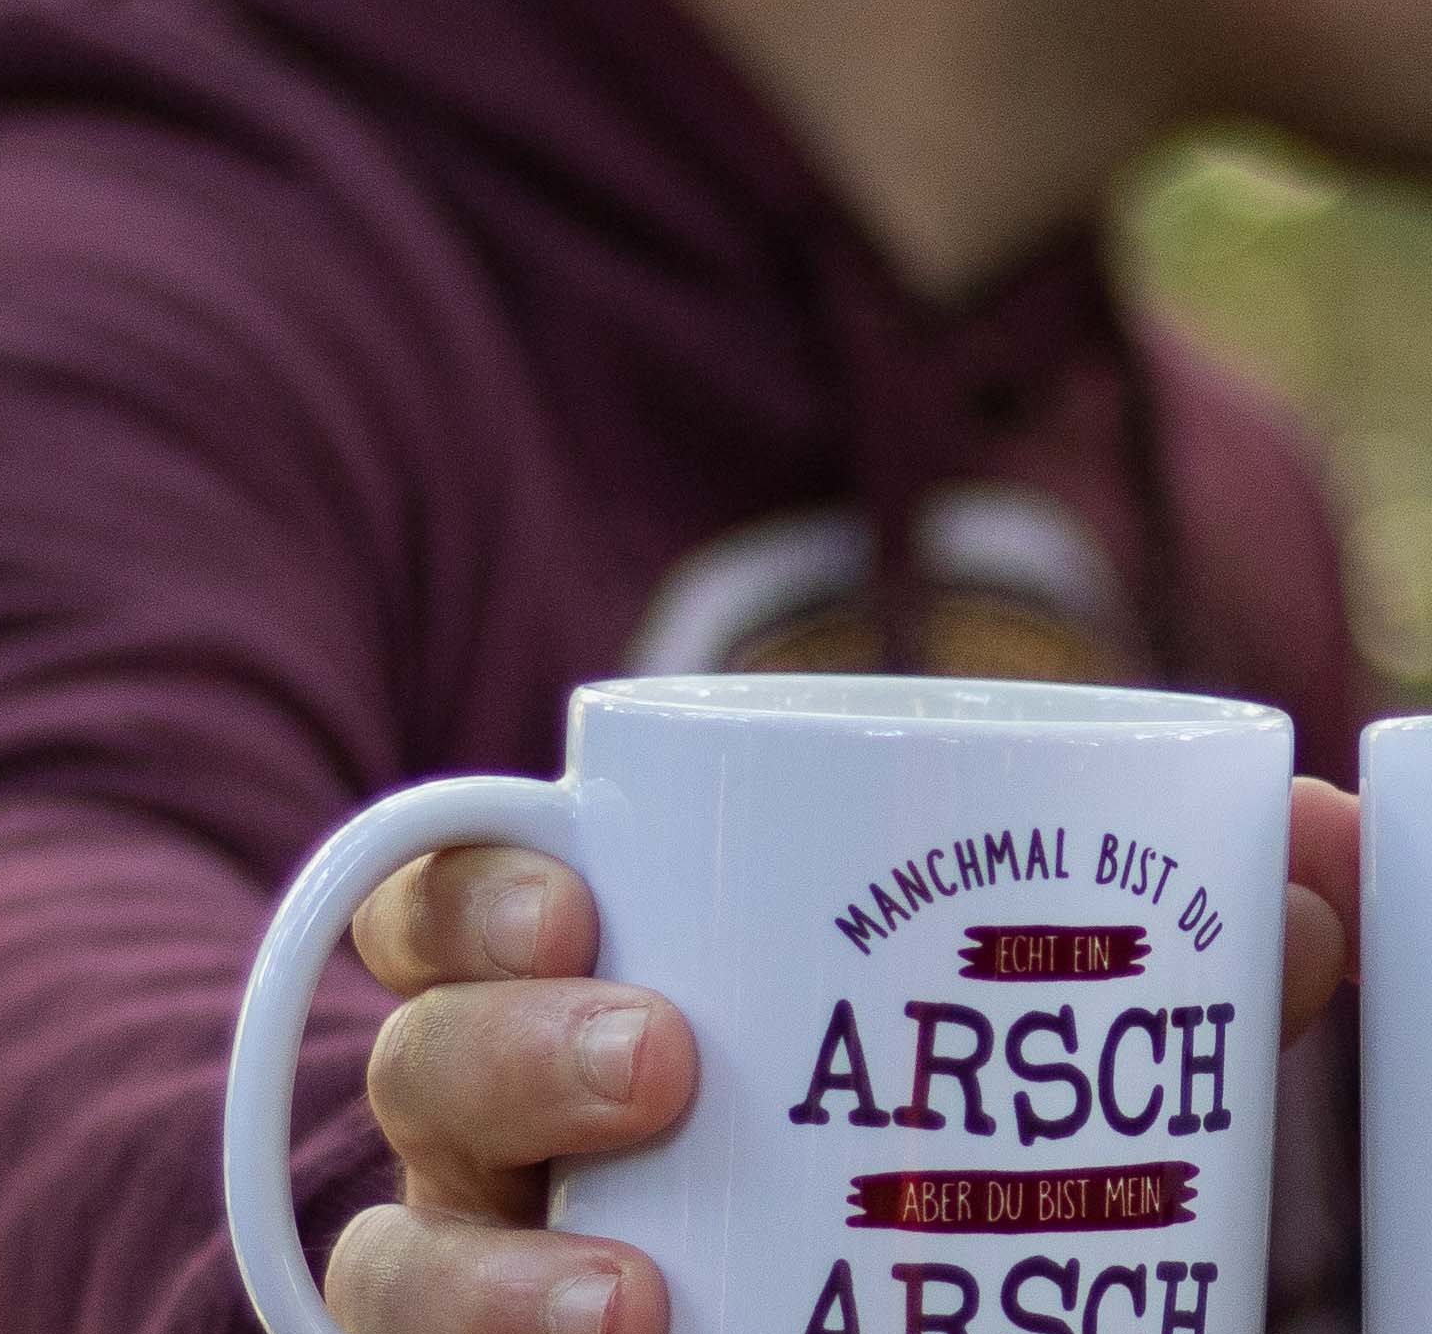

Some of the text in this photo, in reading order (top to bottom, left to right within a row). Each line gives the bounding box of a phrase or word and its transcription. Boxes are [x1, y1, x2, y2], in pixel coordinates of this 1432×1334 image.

[834, 827, 1224, 956] MANCHMAL BIST DU
[997, 934, 1112, 975] ECHT EIN
[788, 998, 1236, 1146] ARSCH
[901, 1174, 1163, 1224] ABER DU BIST MEIN
